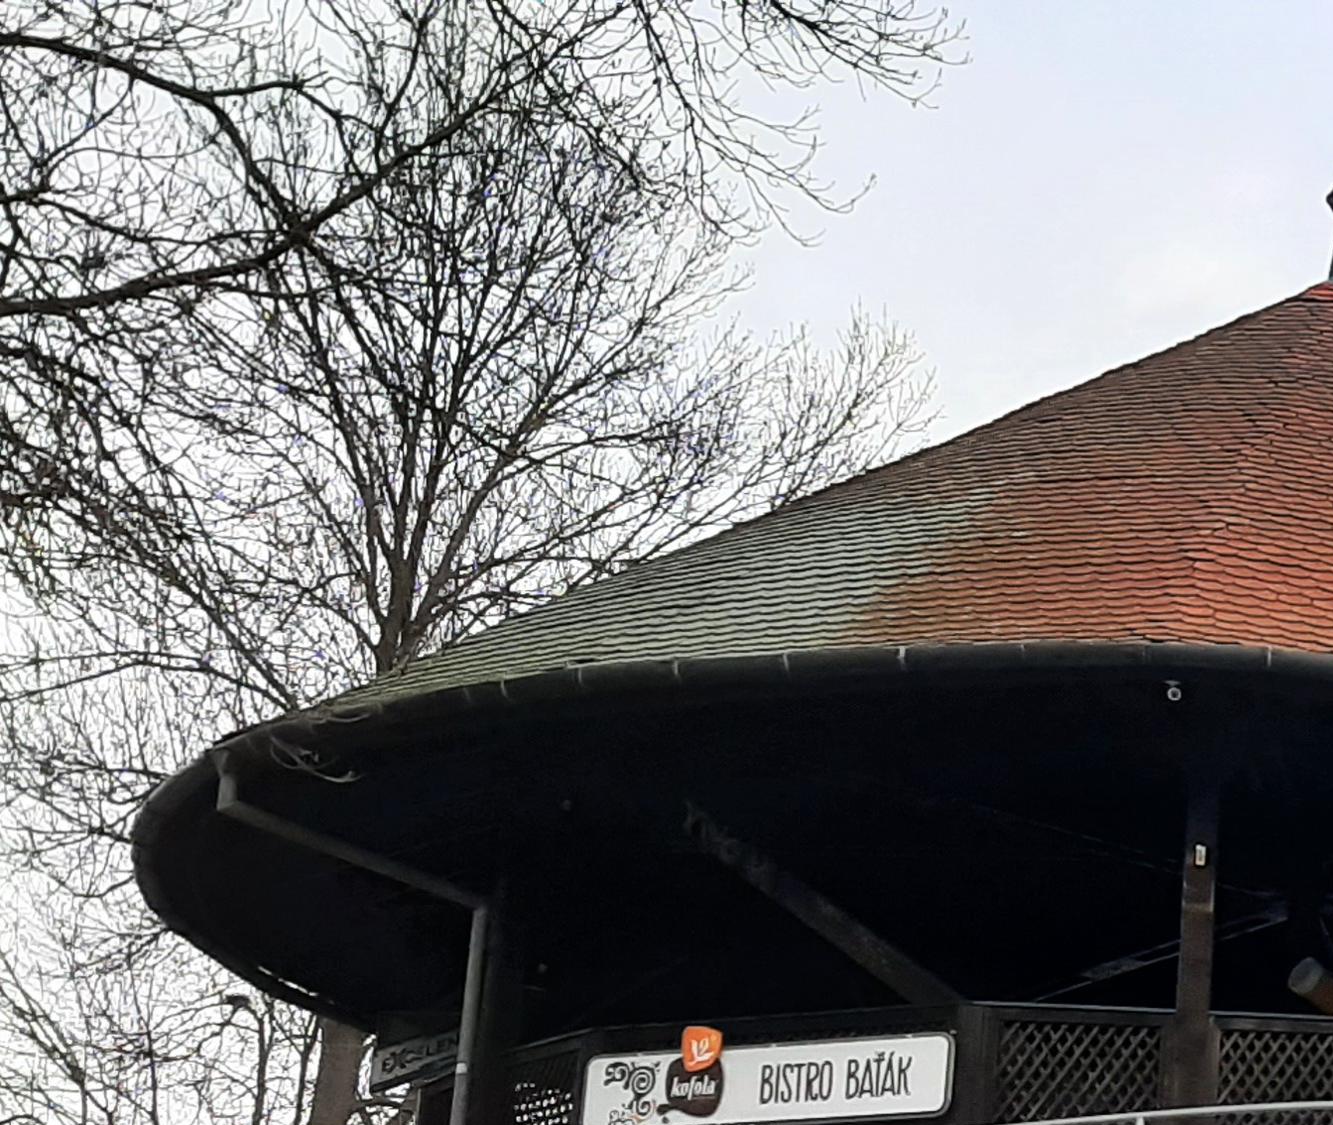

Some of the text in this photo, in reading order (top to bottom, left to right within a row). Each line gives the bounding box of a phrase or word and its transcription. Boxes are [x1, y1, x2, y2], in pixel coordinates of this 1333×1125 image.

[669, 1074, 717, 1101] kofola
[759, 1050, 913, 1105] BISTRO BAŤÁK
